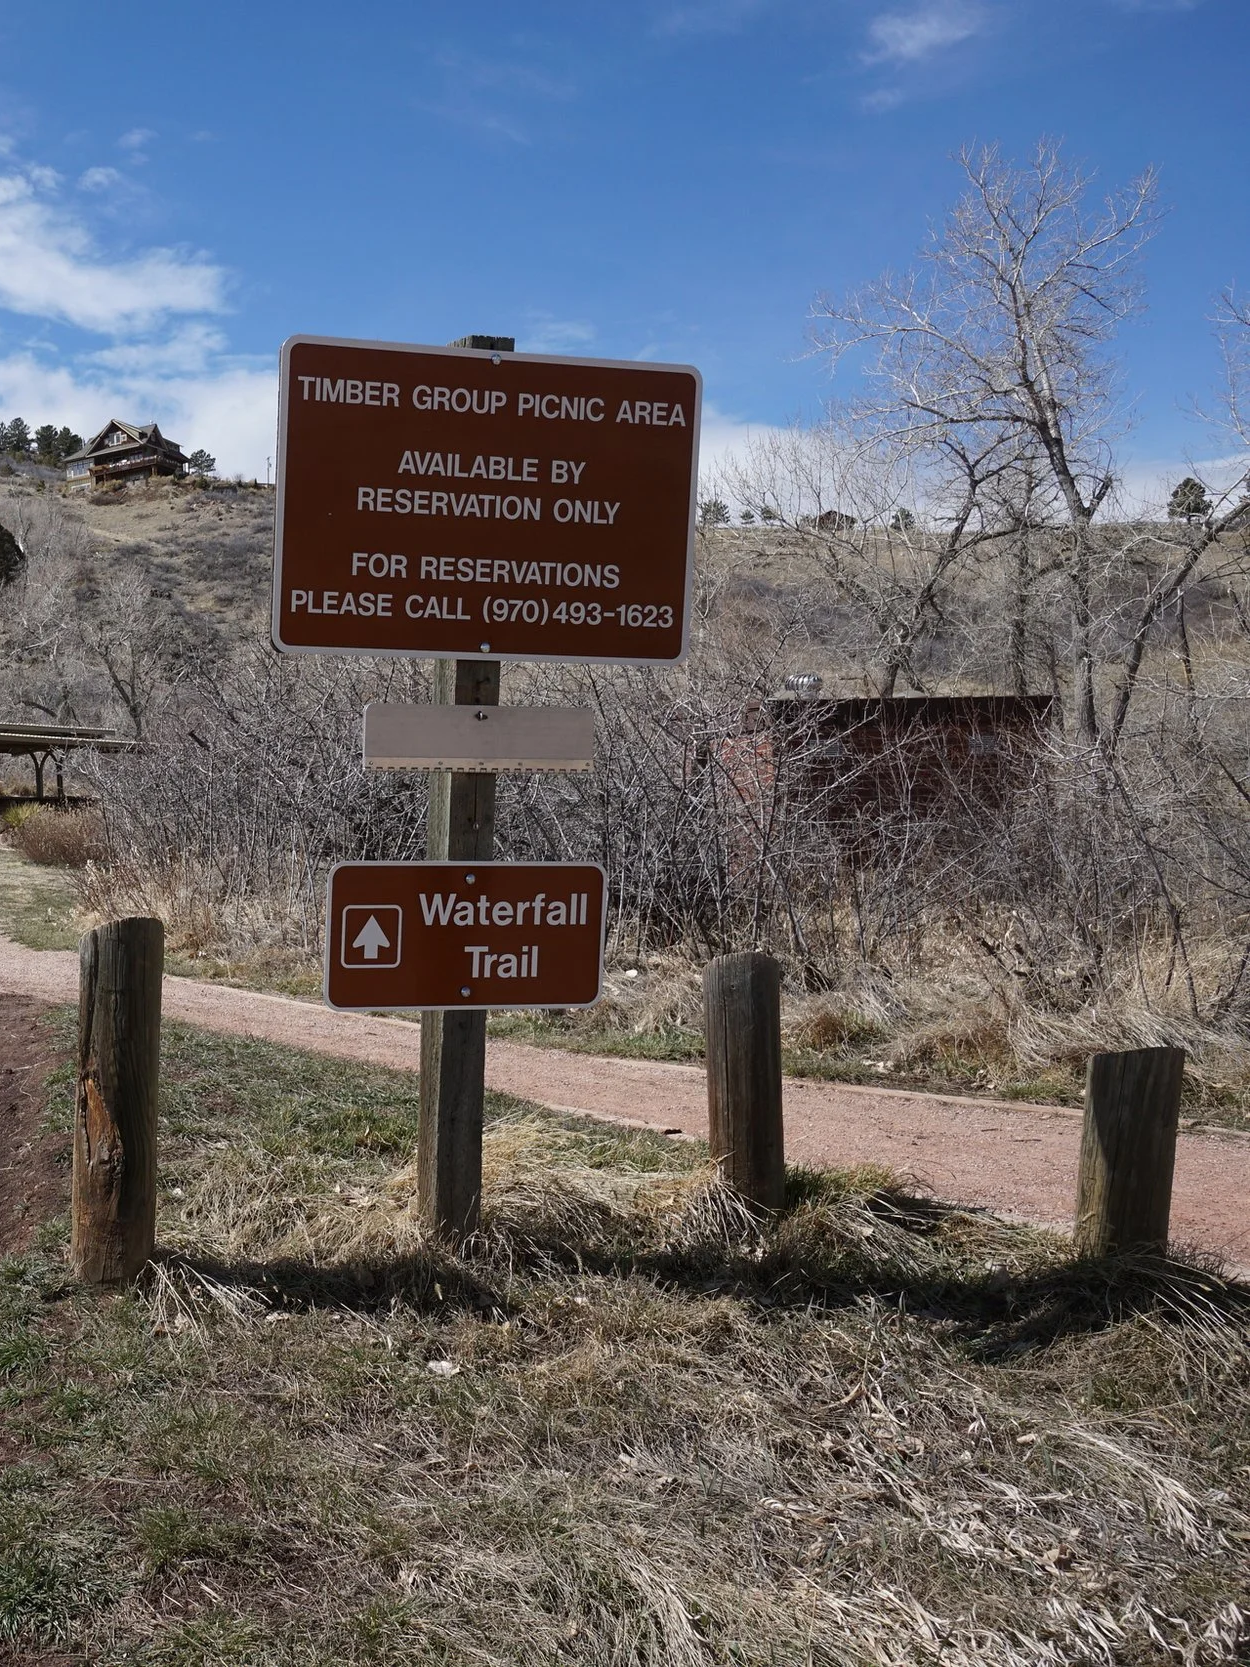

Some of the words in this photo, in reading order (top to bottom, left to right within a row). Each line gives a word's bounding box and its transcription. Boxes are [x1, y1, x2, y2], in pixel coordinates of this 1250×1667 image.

[298, 376, 399, 407] TIMBER
[413, 385, 506, 414] GROUP
[518, 394, 604, 421] PICNIC
[616, 401, 685, 426] AREA
[398, 451, 538, 481] AVAILABLE
[552, 461, 585, 484] BY
[358, 487, 540, 520] RESERVATION
[554, 499, 619, 524] ONLY
[352, 553, 407, 578] FOR
[421, 557, 619, 588] RESERVATIONS
[291, 590, 392, 616] PLEASE
[406, 595, 470, 619] CALL
[483, 597, 673, 627] (970)493-1623
[420, 894, 587, 926] Waterfall
[465, 946, 538, 978] Trail
